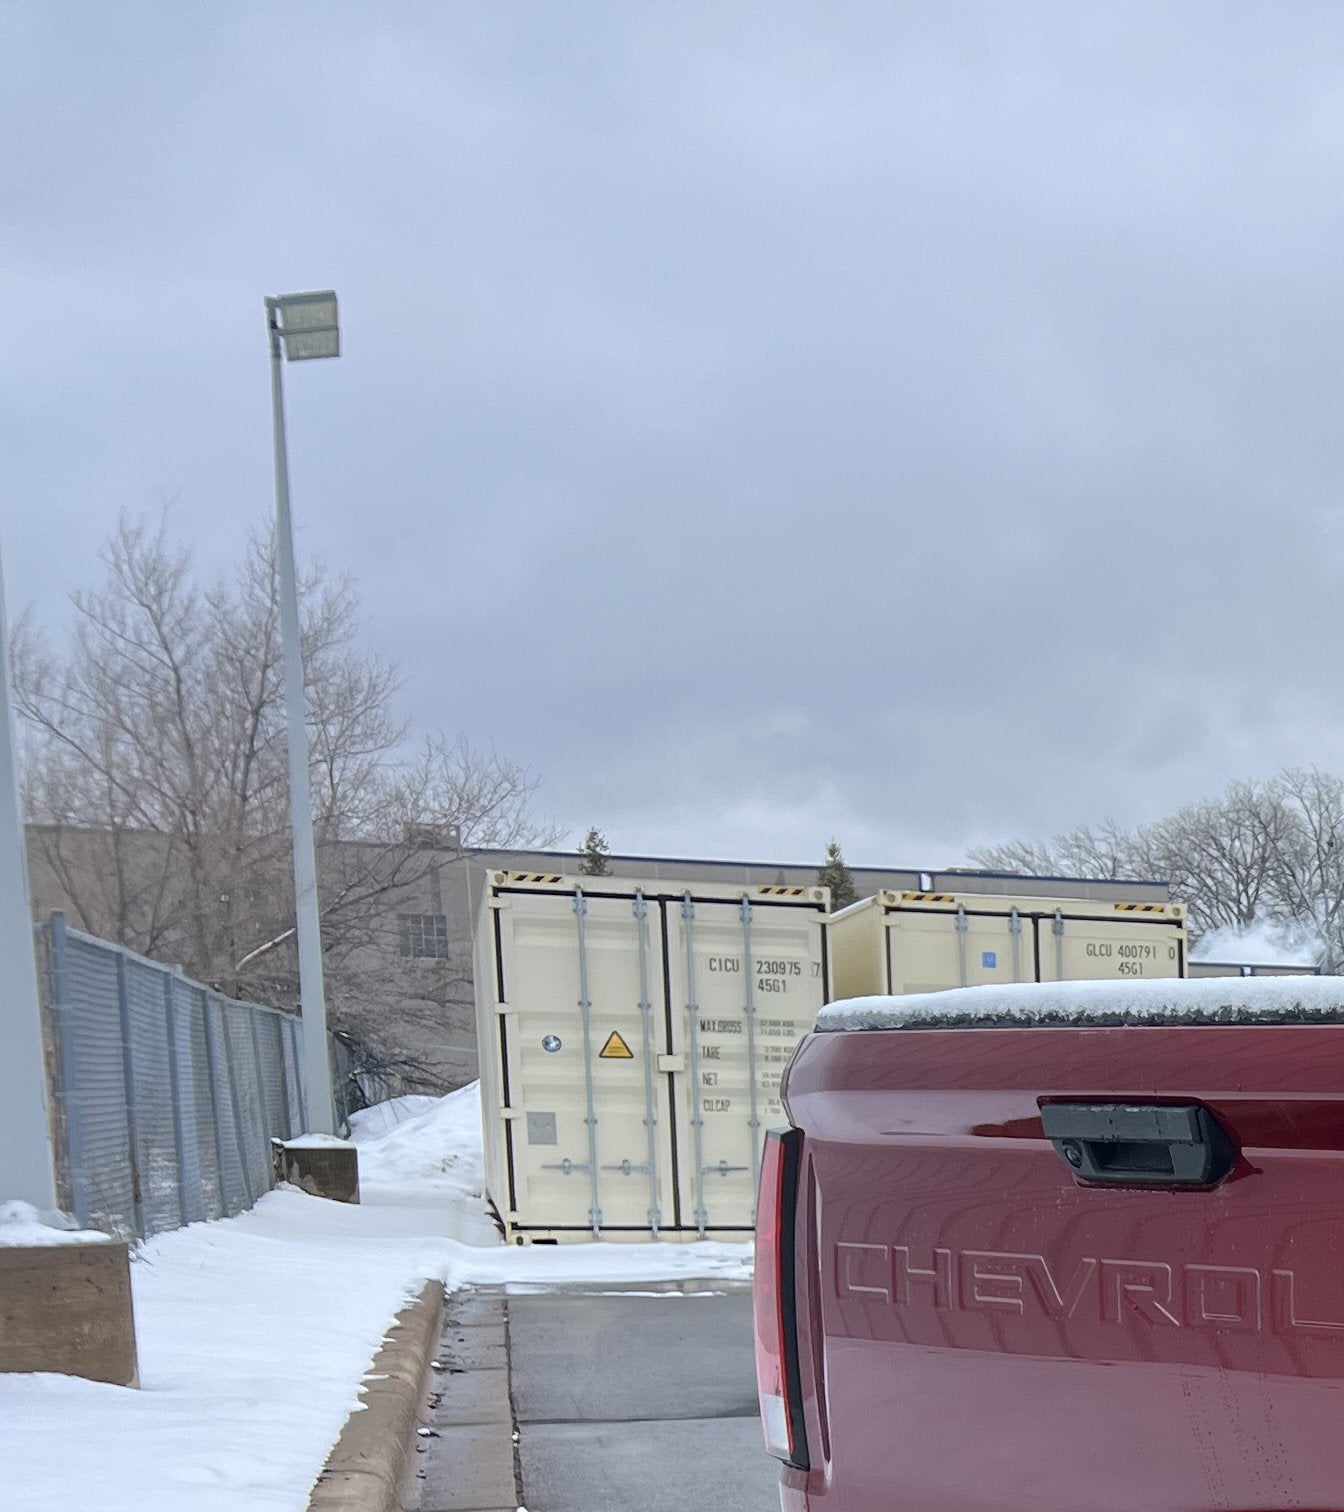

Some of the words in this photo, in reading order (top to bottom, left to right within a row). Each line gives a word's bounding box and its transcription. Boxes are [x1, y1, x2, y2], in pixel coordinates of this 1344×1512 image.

[1086, 943, 1112, 957] GLCU
[1117, 945, 1157, 959] 400791
[709, 957, 740, 973] CICU
[756, 960, 801, 976] 230975
[1118, 961, 1143, 976] 45G1
[757, 978, 787, 993] 45G1
[702, 1072, 719, 1086] NET
